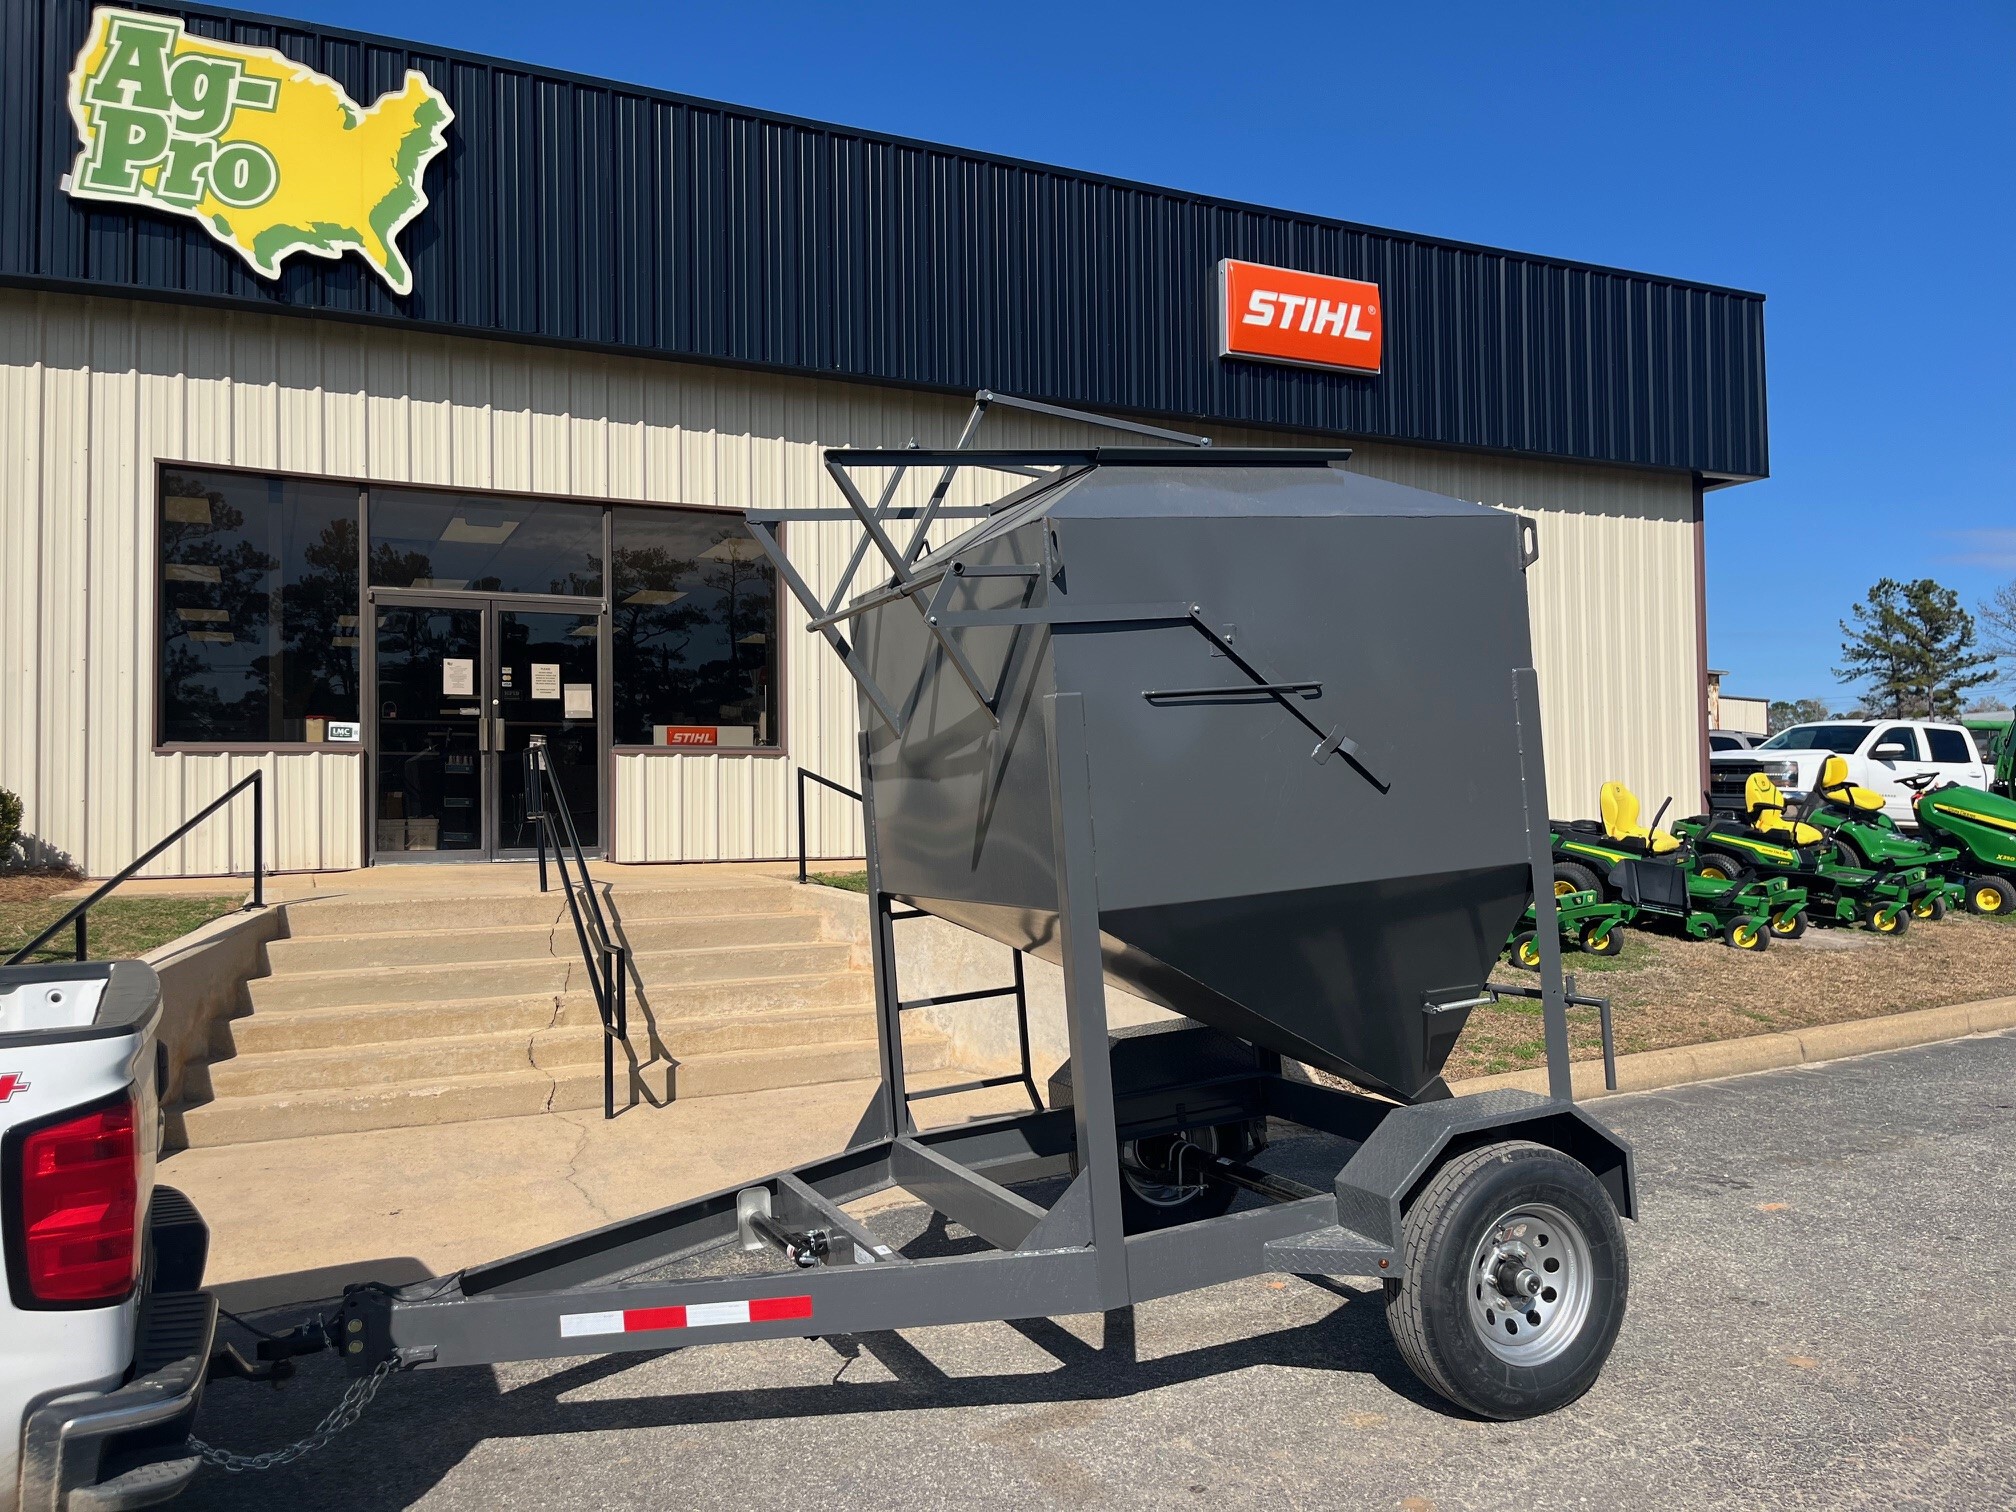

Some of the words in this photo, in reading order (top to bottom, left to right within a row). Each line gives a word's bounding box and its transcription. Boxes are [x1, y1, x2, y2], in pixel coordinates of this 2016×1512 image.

[86, 18, 277, 138] Ag-
[82, 104, 279, 206] Pro
[1242, 288, 1373, 342] STIHL
[332, 727, 351, 735] LMC
[672, 732, 713, 743] STIHL
